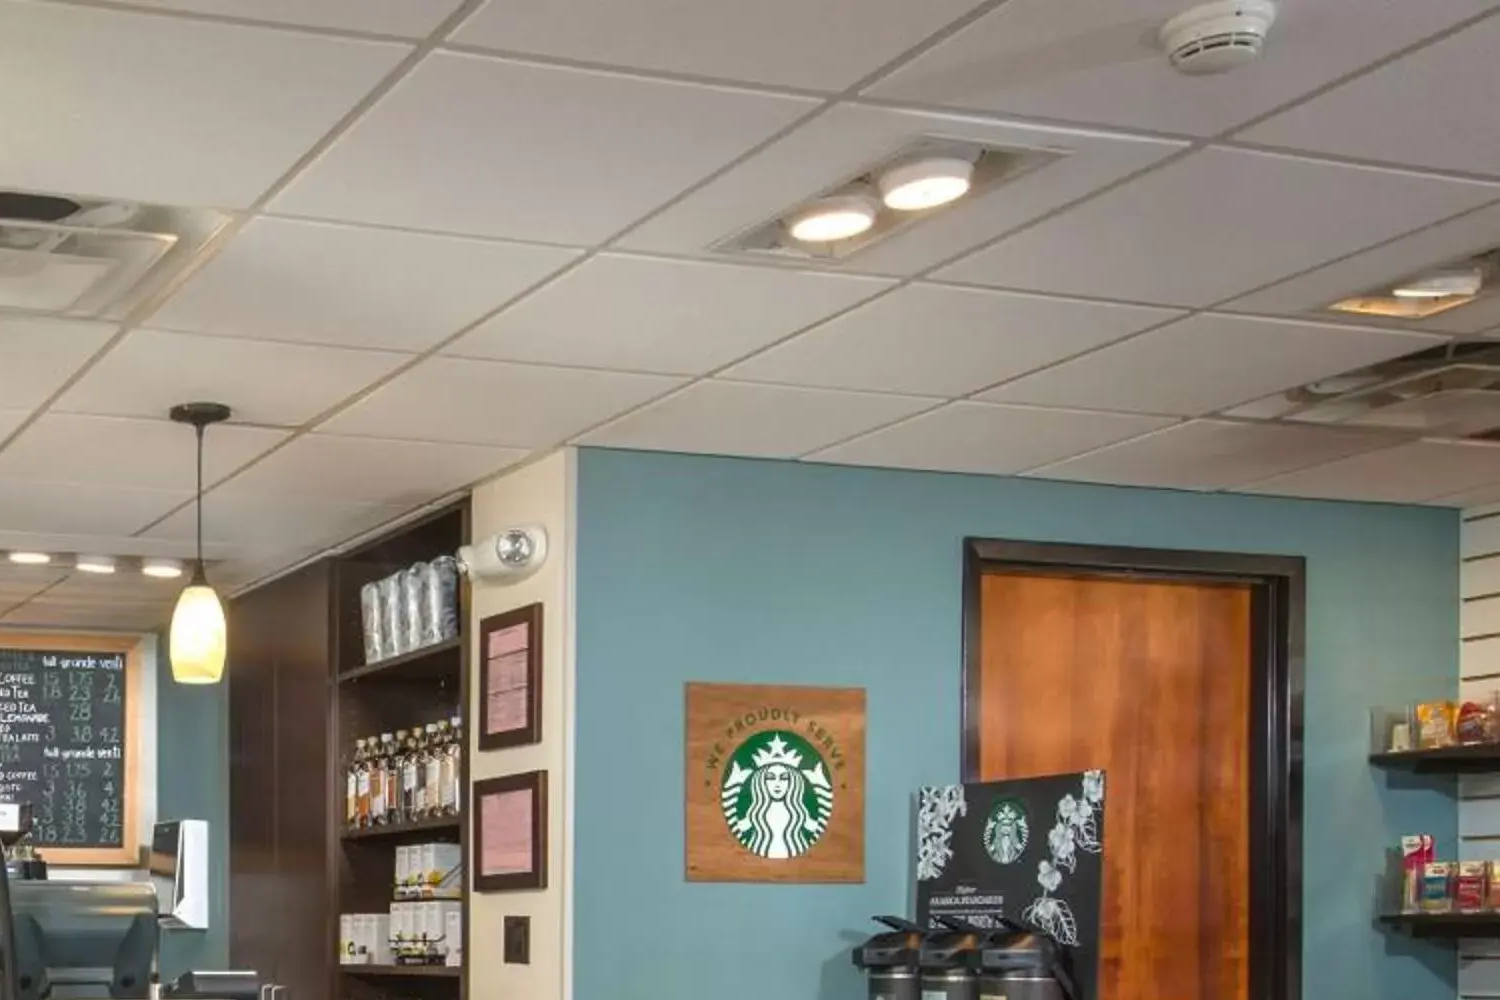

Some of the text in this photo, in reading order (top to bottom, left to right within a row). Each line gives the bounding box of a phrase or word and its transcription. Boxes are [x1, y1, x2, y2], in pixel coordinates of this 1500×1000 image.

[707, 707, 845, 770] WE PROUDLY SERVE
[103, 762, 113, 776] 2
[103, 782, 114, 796] 4
